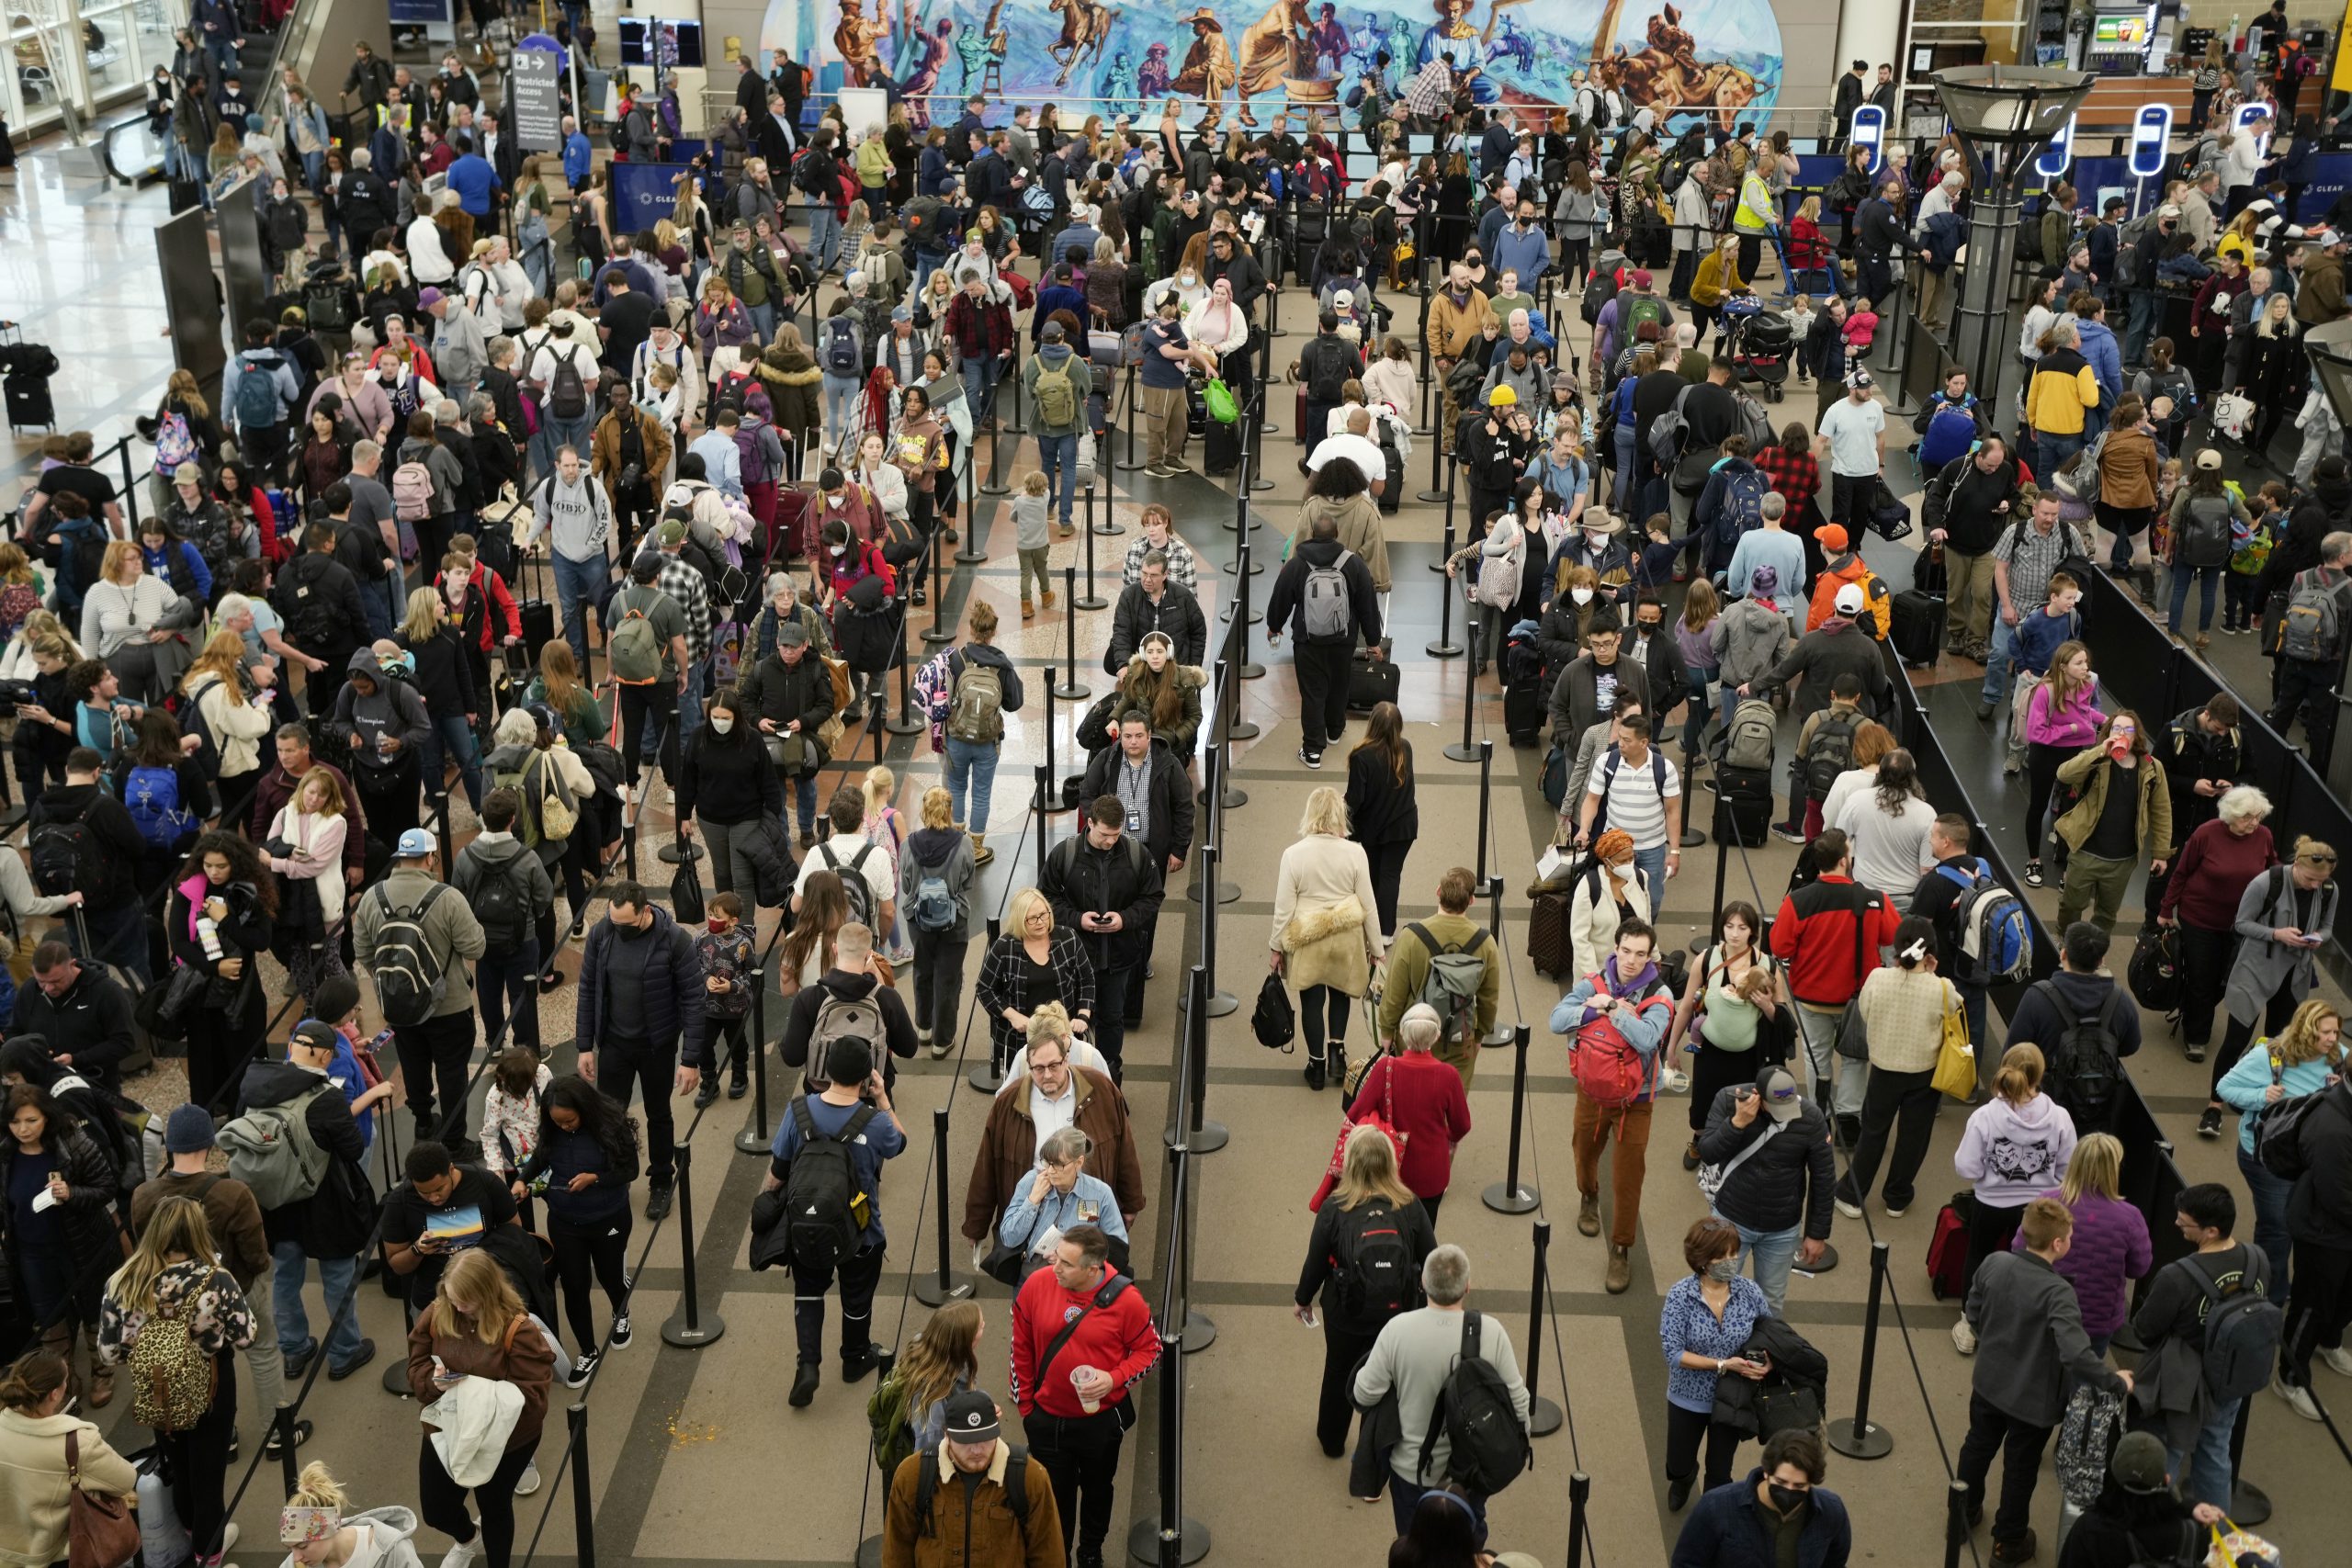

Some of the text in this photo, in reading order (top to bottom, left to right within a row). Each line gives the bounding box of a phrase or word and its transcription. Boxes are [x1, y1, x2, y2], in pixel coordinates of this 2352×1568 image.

[515, 76, 556, 88] Restricted
[515, 86, 543, 96] Access
[221, 103, 246, 117] GAP
[356, 716, 386, 727] Champion
